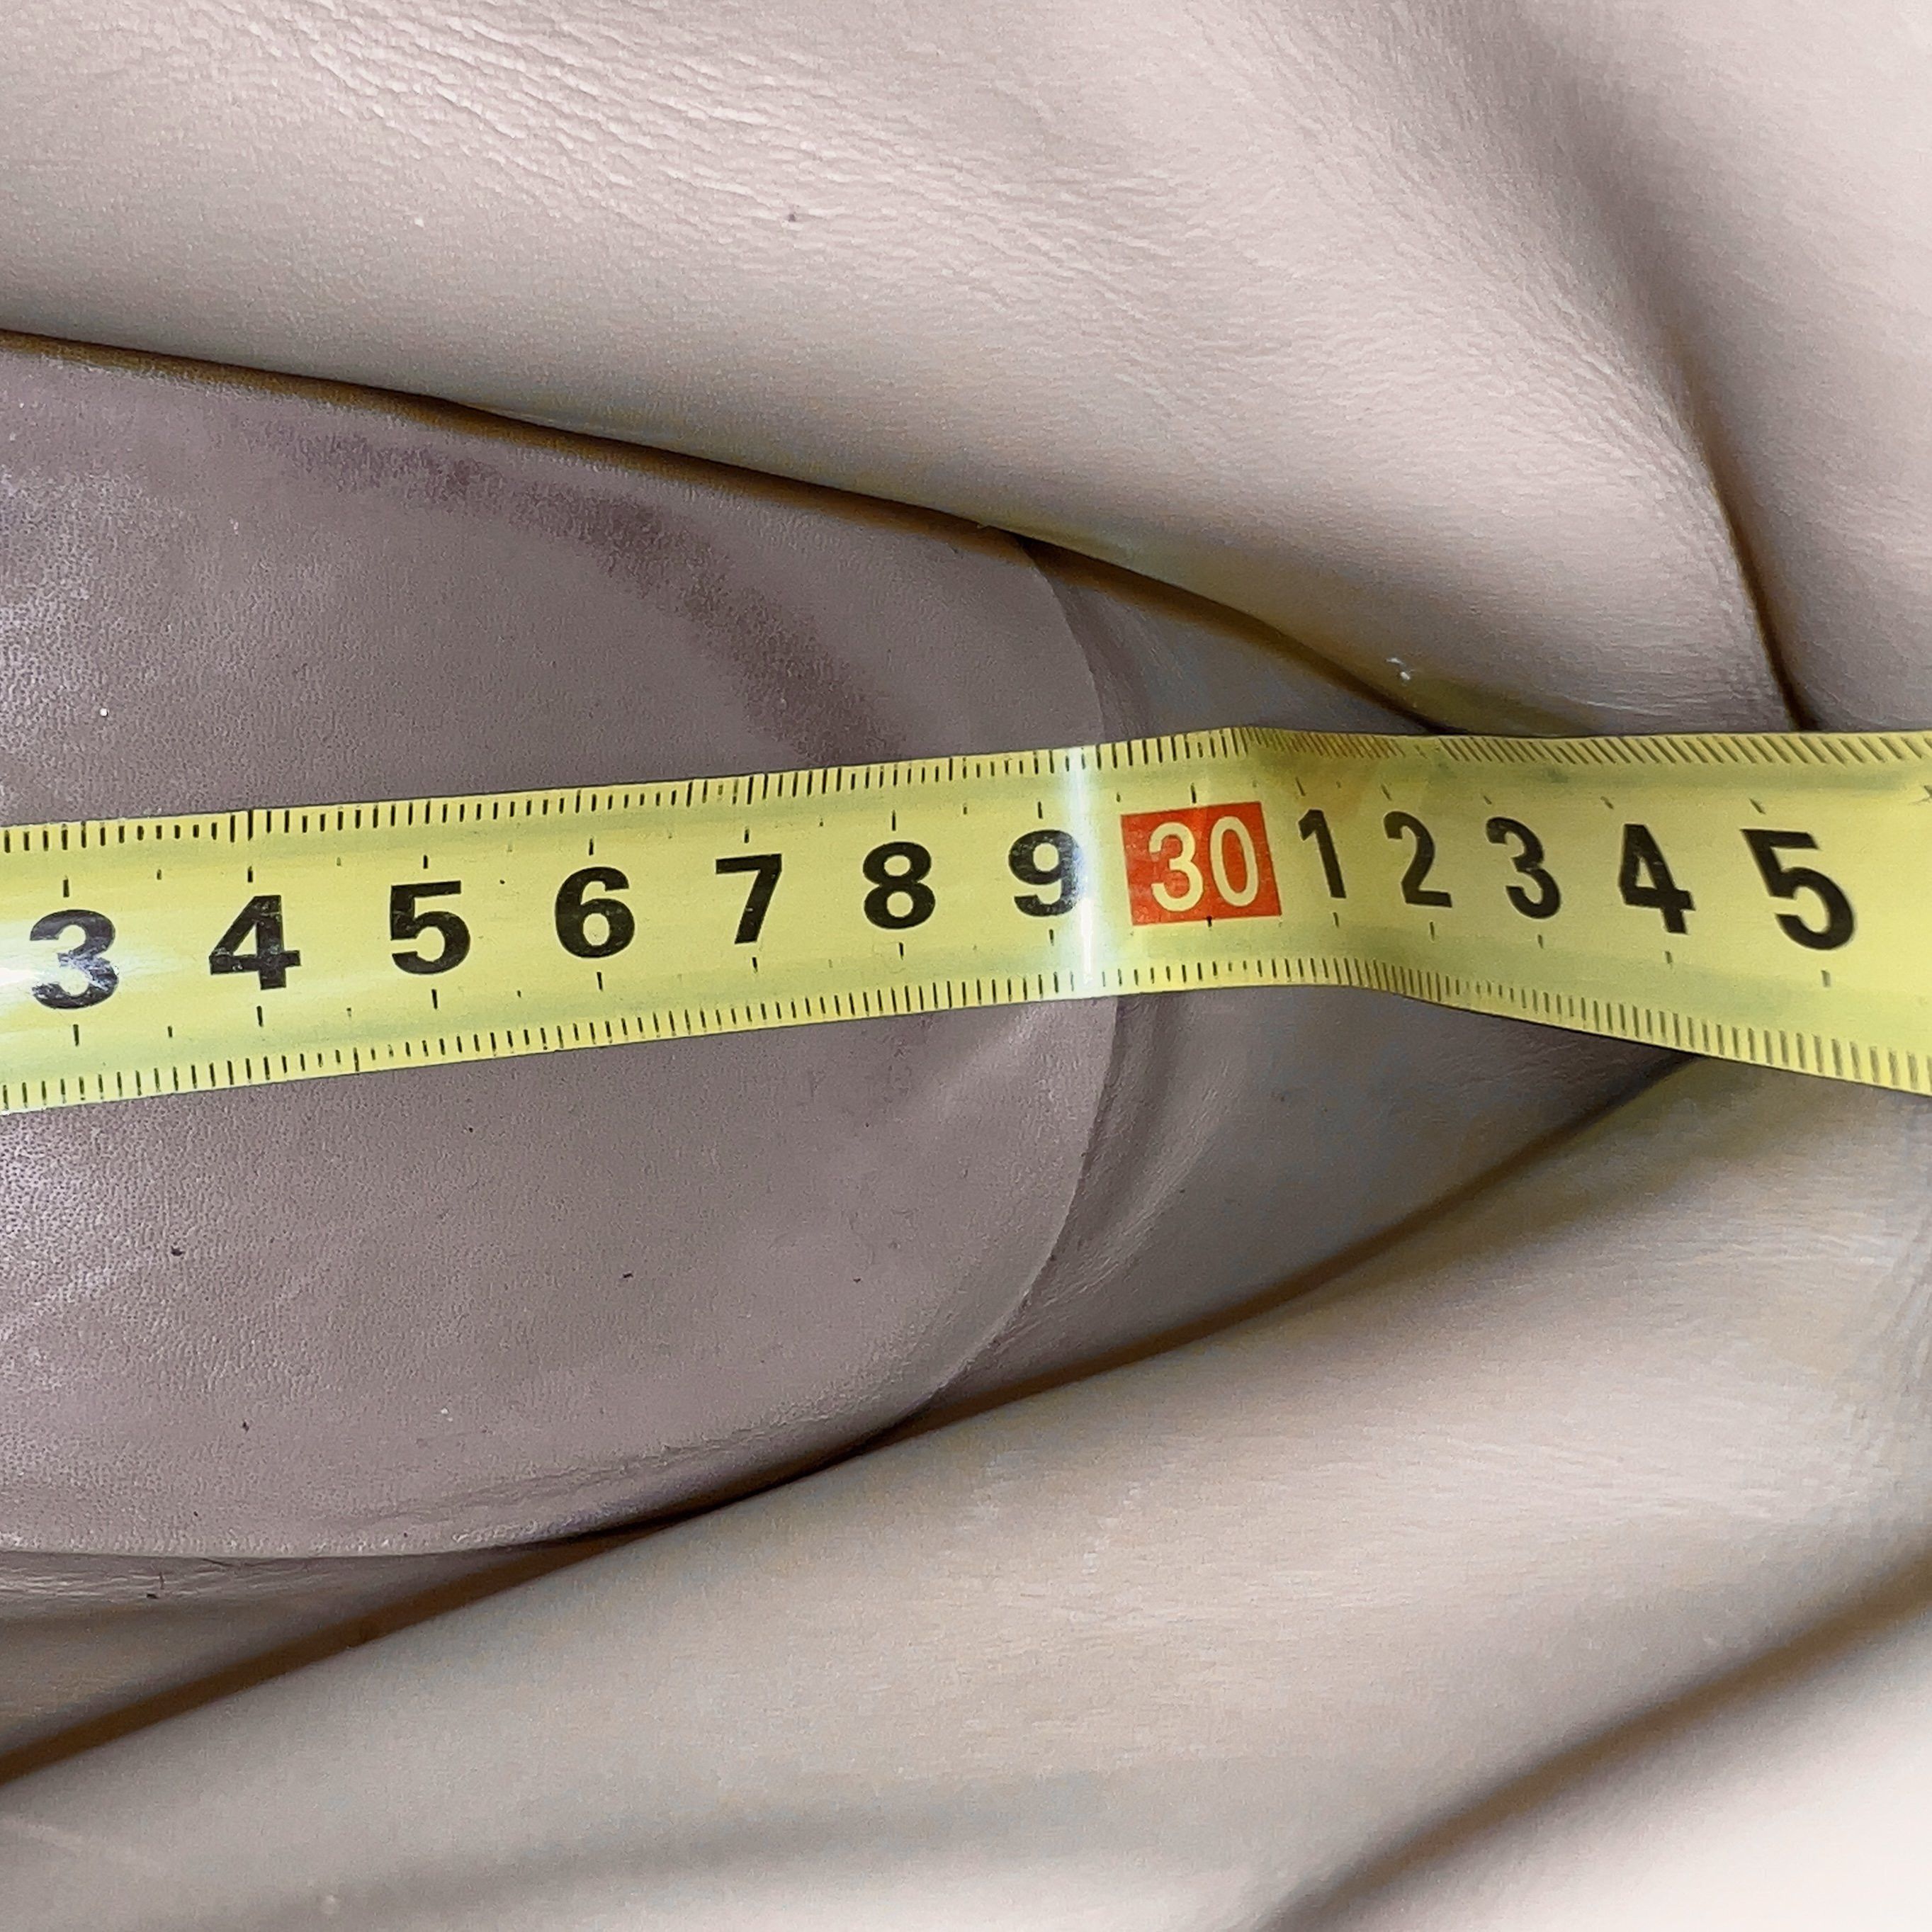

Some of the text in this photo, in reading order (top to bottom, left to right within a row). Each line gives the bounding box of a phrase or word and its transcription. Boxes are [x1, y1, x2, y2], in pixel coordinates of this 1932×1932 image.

[30, 808, 1855, 1010] 3 4 5 6 7 8 9 30 1 2 3 4 5
